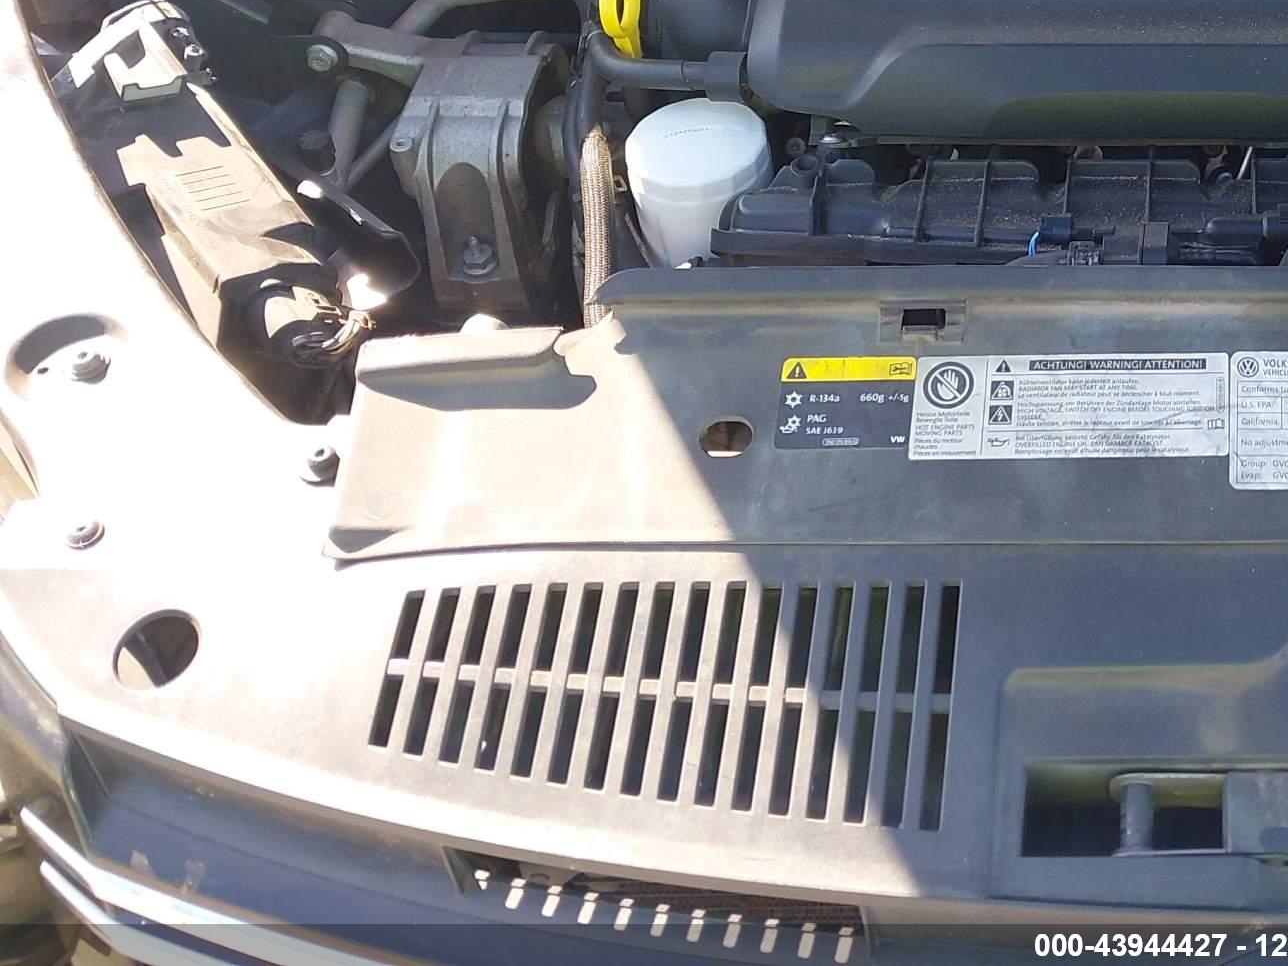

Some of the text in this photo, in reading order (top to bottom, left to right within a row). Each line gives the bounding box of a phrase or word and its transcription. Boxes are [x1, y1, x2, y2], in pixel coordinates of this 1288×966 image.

[1033, 360, 1203, 370] ACHTUNG! WARNING! ATTENTION!
[1241, 385, 1279, 393] Conforms
[809, 392, 910, 403] R-134a 660g +/-5g
[806, 414, 827, 423] PAG
[806, 427, 821, 435] SAE
[890, 435, 906, 444] VW
[1241, 438, 1253, 446] No
